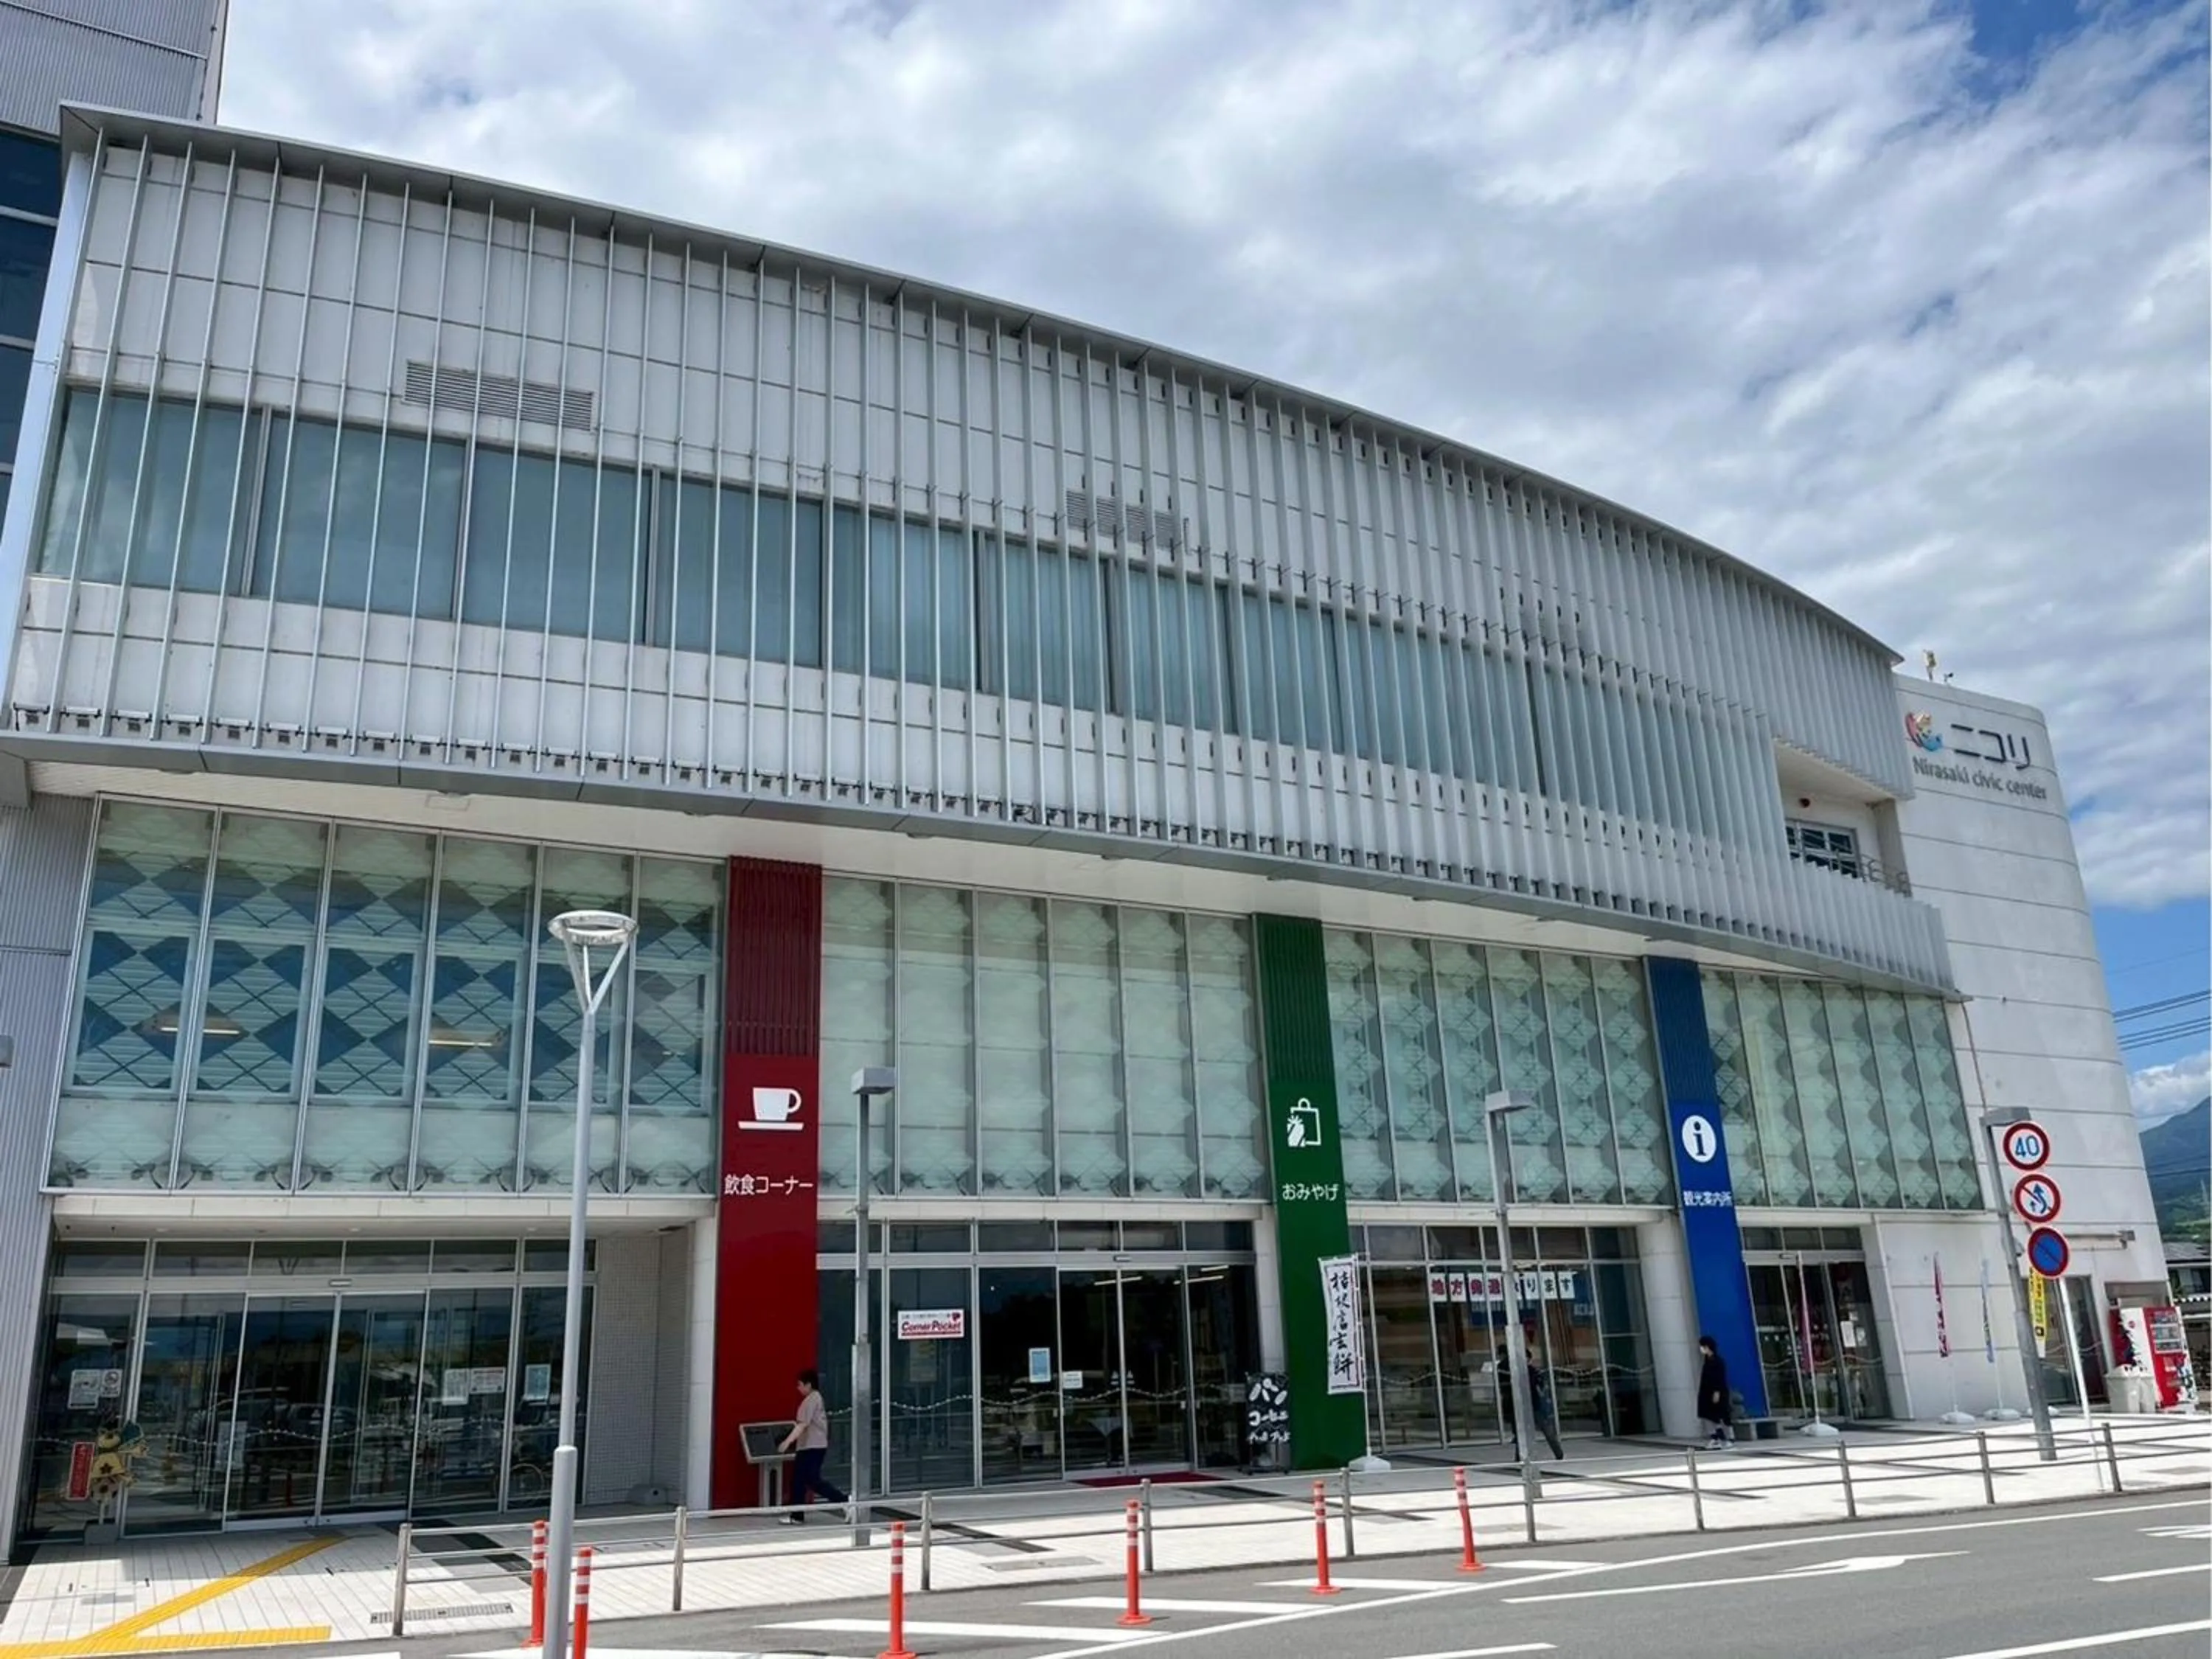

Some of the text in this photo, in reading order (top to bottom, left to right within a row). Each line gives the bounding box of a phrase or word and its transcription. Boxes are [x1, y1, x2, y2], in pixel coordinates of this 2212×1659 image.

[1950, 723, 2030, 771] ニコリ
[1913, 757, 2048, 800] Nirasaki civic center
[2014, 1135, 2040, 1158] 40
[724, 1173, 813, 1195] 飲食コーナー
[1282, 1183, 1339, 1201] おみやげ
[1683, 1190, 1732, 1207] 観光案内所
[1431, 1276, 1572, 1296] 地方発送ります
[1248, 1377, 1288, 1405] パン
